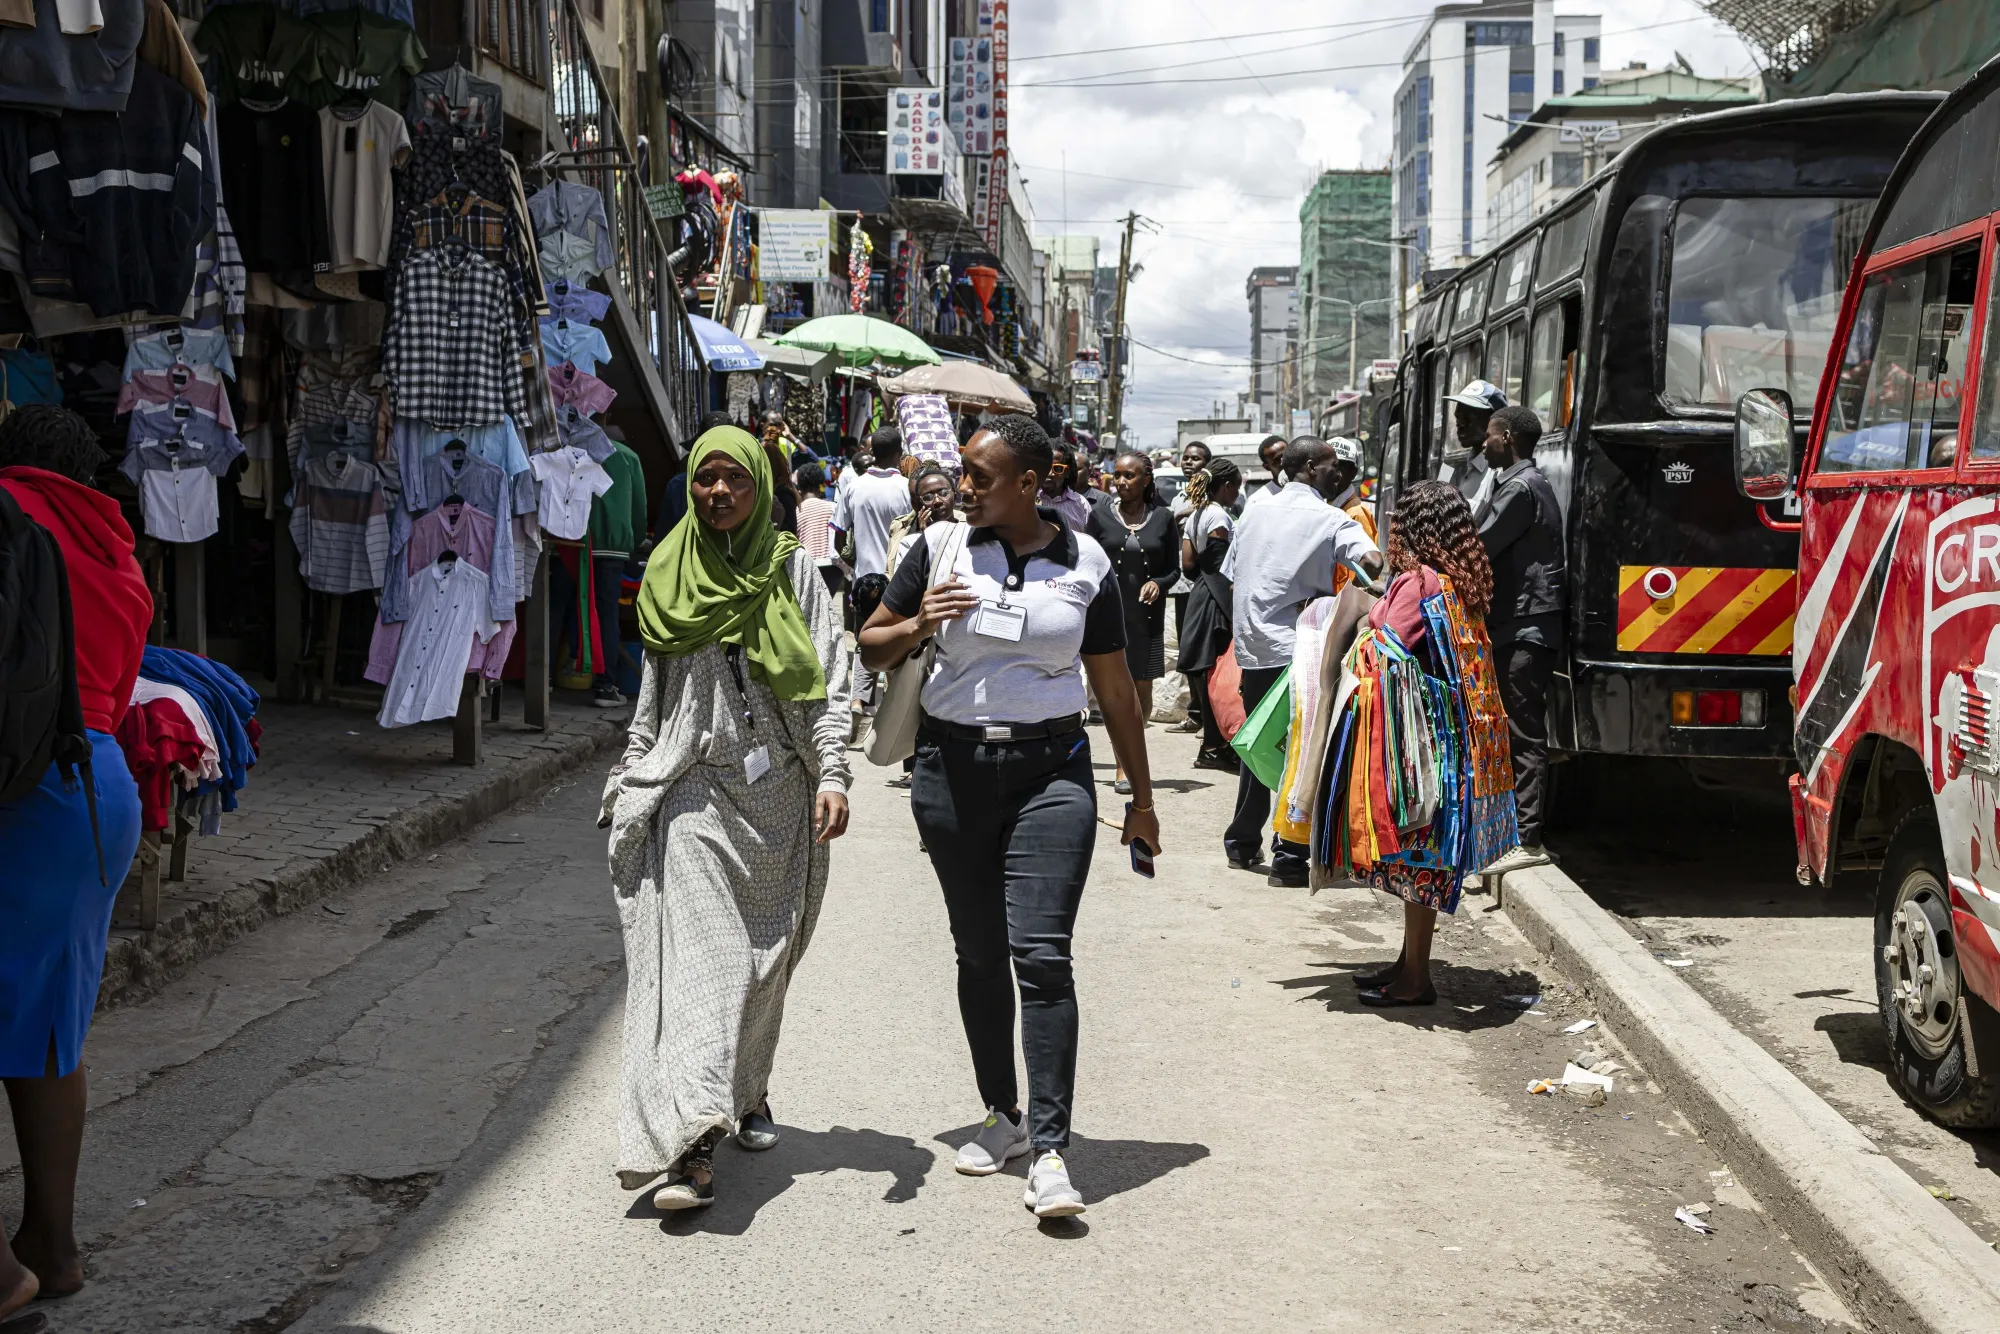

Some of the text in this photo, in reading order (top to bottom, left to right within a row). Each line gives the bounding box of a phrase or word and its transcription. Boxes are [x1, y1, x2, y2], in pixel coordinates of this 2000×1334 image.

[965, 39, 975, 154] JAABO BAGS
[912, 92, 922, 169] JAABO BAGS
[710, 345, 745, 353] TECNO
[722, 358, 750, 367] TECNO
[1667, 471, 1690, 481] PSV
